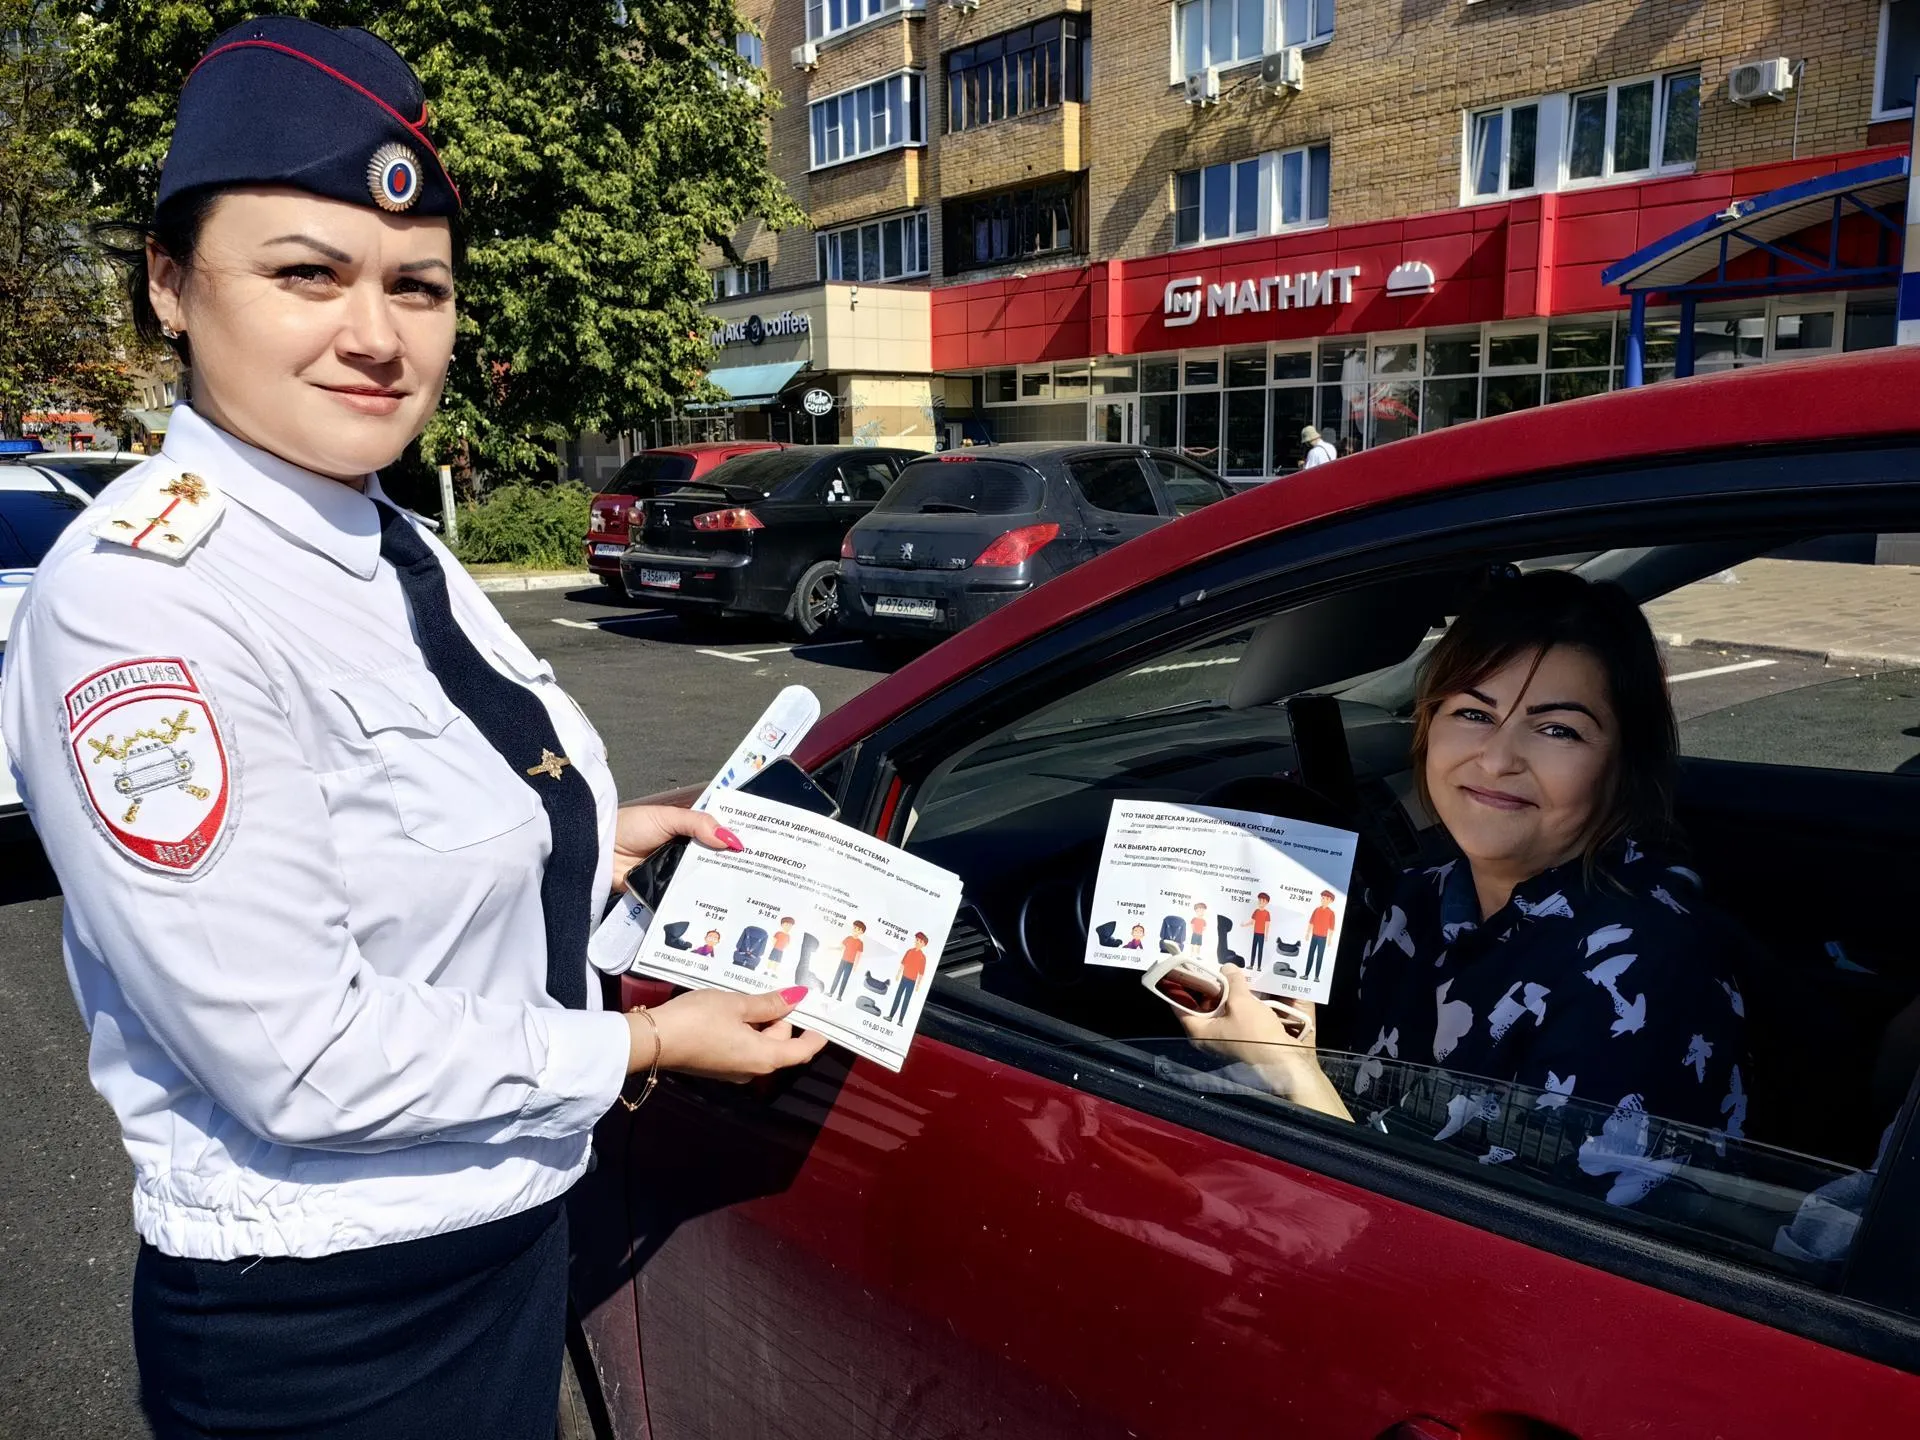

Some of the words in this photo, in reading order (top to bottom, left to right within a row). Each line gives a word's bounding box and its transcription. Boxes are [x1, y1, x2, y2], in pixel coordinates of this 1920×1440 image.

[1207, 265, 1360, 317] МАГНИТ
[764, 311, 809, 336] coffee
[72, 664, 185, 716] ПОЛИЦИЯ
[1155, 814, 1185, 822] ДЕТСКАЯ
[1186, 816, 1246, 829] УДЕРЖИВАЮЩАЯ
[1247, 823, 1285, 836] СИСТЕМА?
[720, 805, 734, 815] ЧТО
[734, 808, 758, 820] ТАКОЕ
[757, 814, 791, 828] ДЕТСКАЯ
[791, 822, 854, 849] УДЕРЖИВАЮЩАЯ
[853, 845, 890, 865] СИСТЕМА?
[154, 831, 208, 865] МВД
[1127, 843, 1157, 852] ВЫБРАТЬ
[1158, 846, 1206, 857] АВТОКРЕСЛО?
[755, 850, 807, 870] АВТОКРЕСЛО?
[1164, 890, 1192, 900] категория
[1225, 887, 1252, 896] категория
[1284, 886, 1313, 896] категория
[699, 902, 729, 915] категория
[751, 899, 781, 913] категория
[1120, 901, 1146, 909] категория
[881, 919, 909, 935] категория
